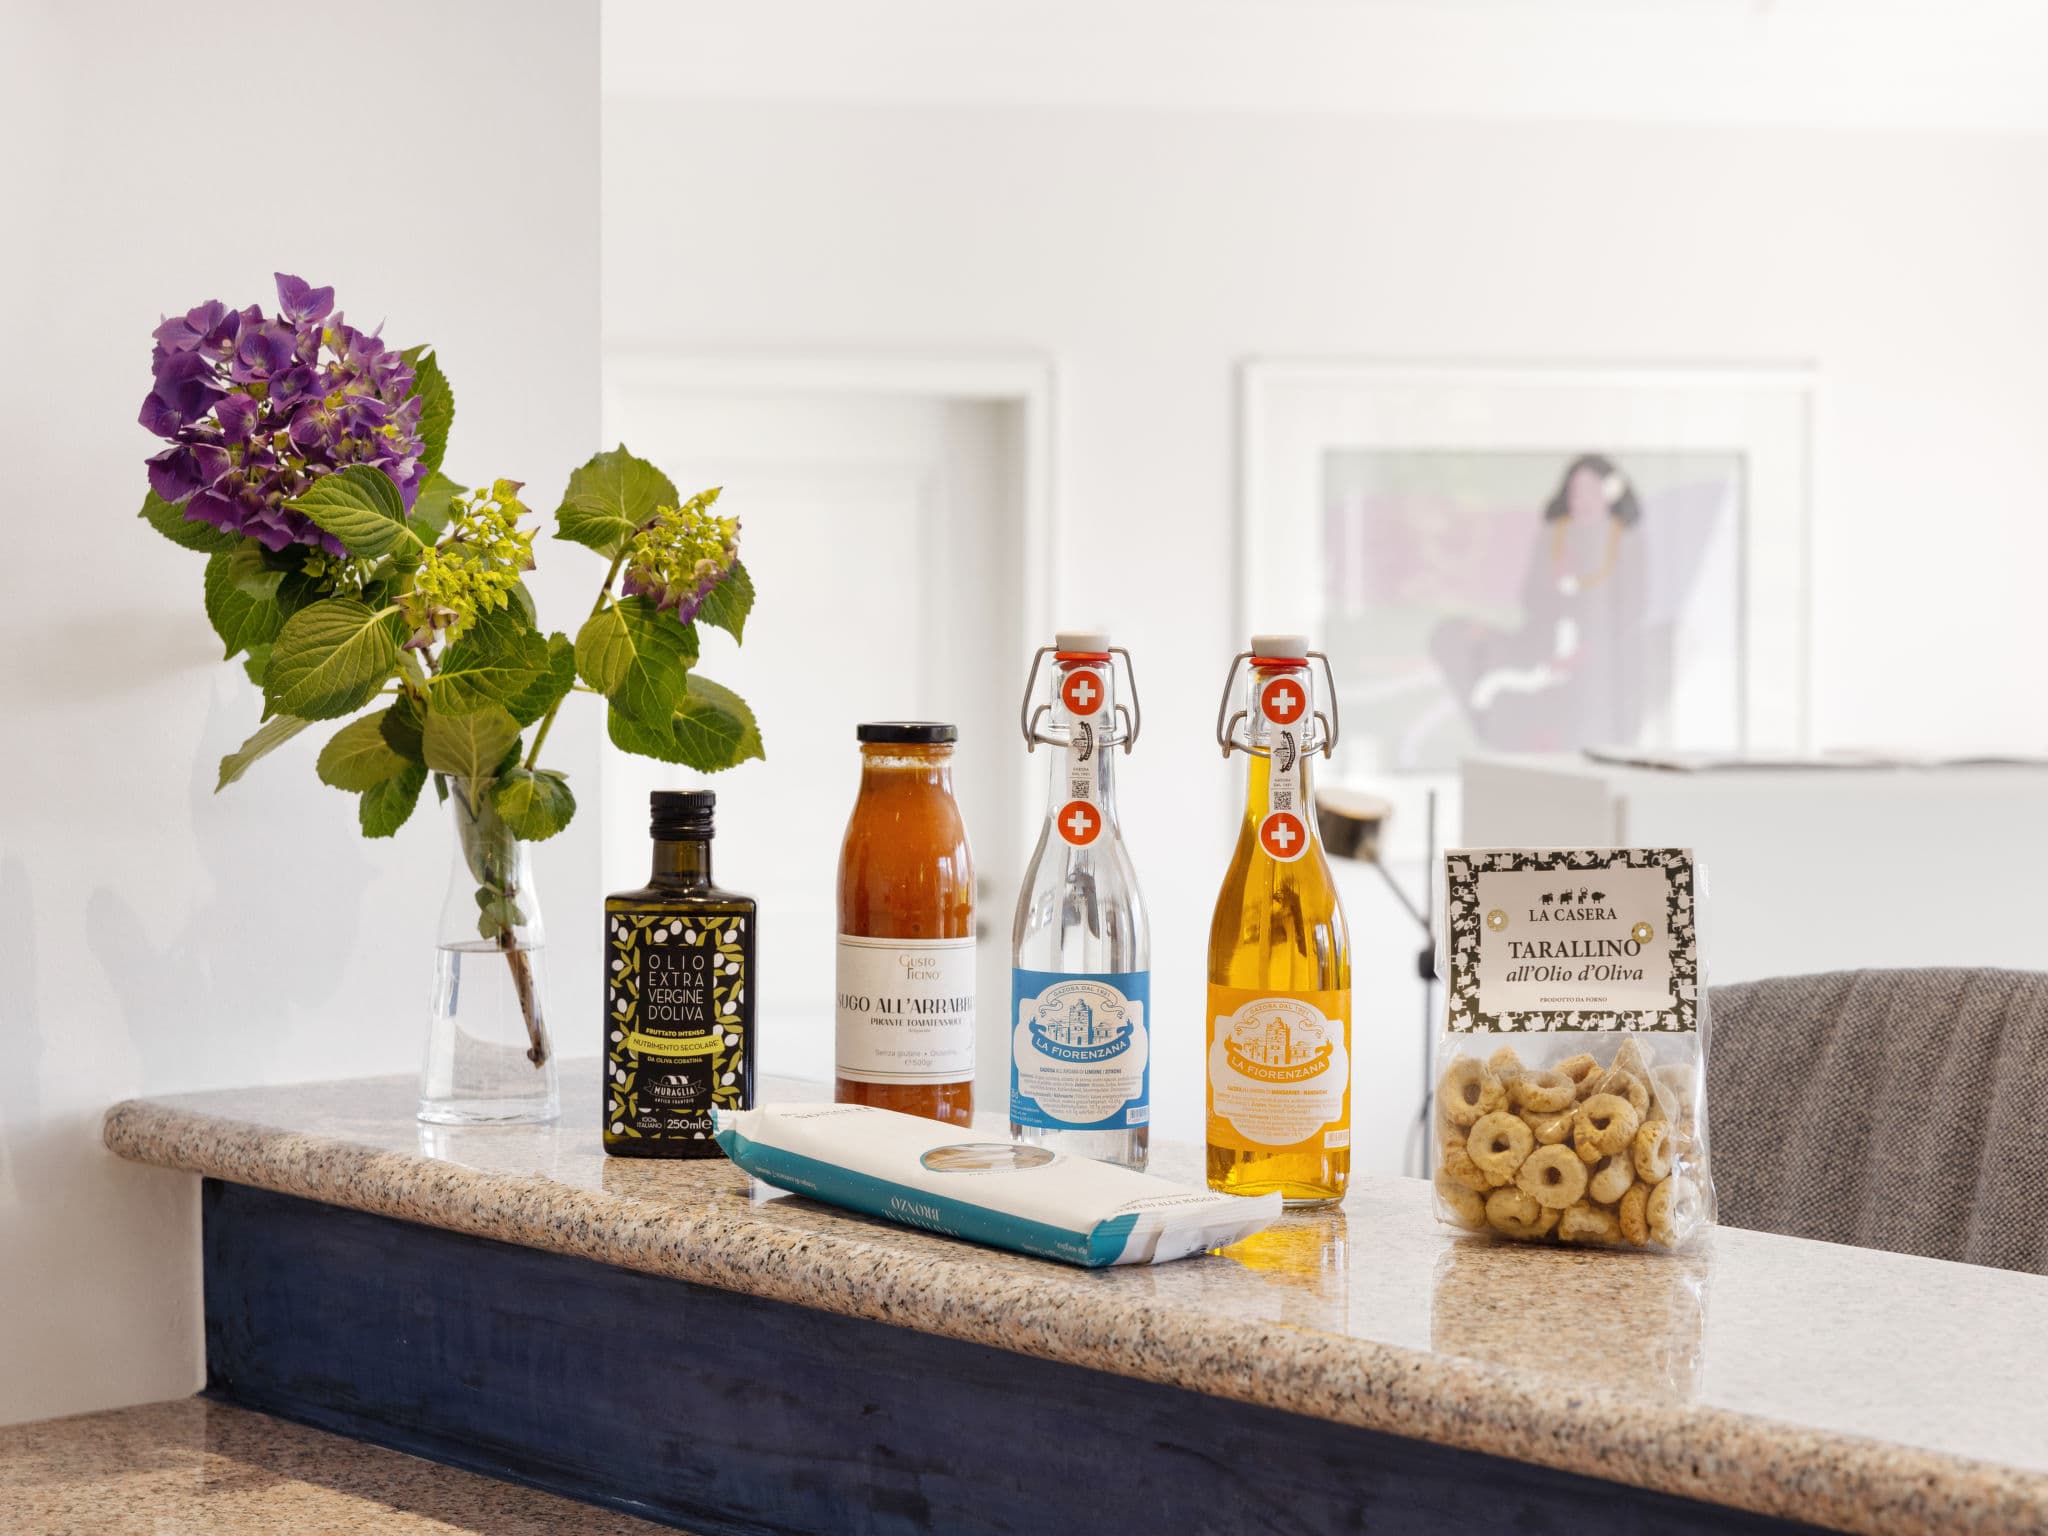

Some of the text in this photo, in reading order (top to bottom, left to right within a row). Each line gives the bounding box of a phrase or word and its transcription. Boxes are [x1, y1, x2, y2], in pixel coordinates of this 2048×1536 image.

[1528, 907, 1618, 922] LA CASERA
[1507, 938, 1641, 959] TARALLINO
[648, 954, 704, 970] OLIO
[899, 953, 936, 968] GUSTO
[648, 971, 705, 987] EXTRA
[1506, 964, 1643, 982] all'Olio d'Oliva
[647, 988, 704, 1004] VERGINE
[1053, 985, 1079, 996] GAZOSA
[648, 1005, 704, 1021] D'OLIVA
[645, 1027, 705, 1037] FRUTTATO INTENSO
[633, 1038, 680, 1051] NUTRIMENTO
[1036, 1037, 1127, 1060] LA FIORENZANA
[1231, 1056, 1326, 1080] LA FIORENZANA
[654, 1086, 695, 1097] MURAGLIA
[890, 1196, 939, 1221] BRONZO
